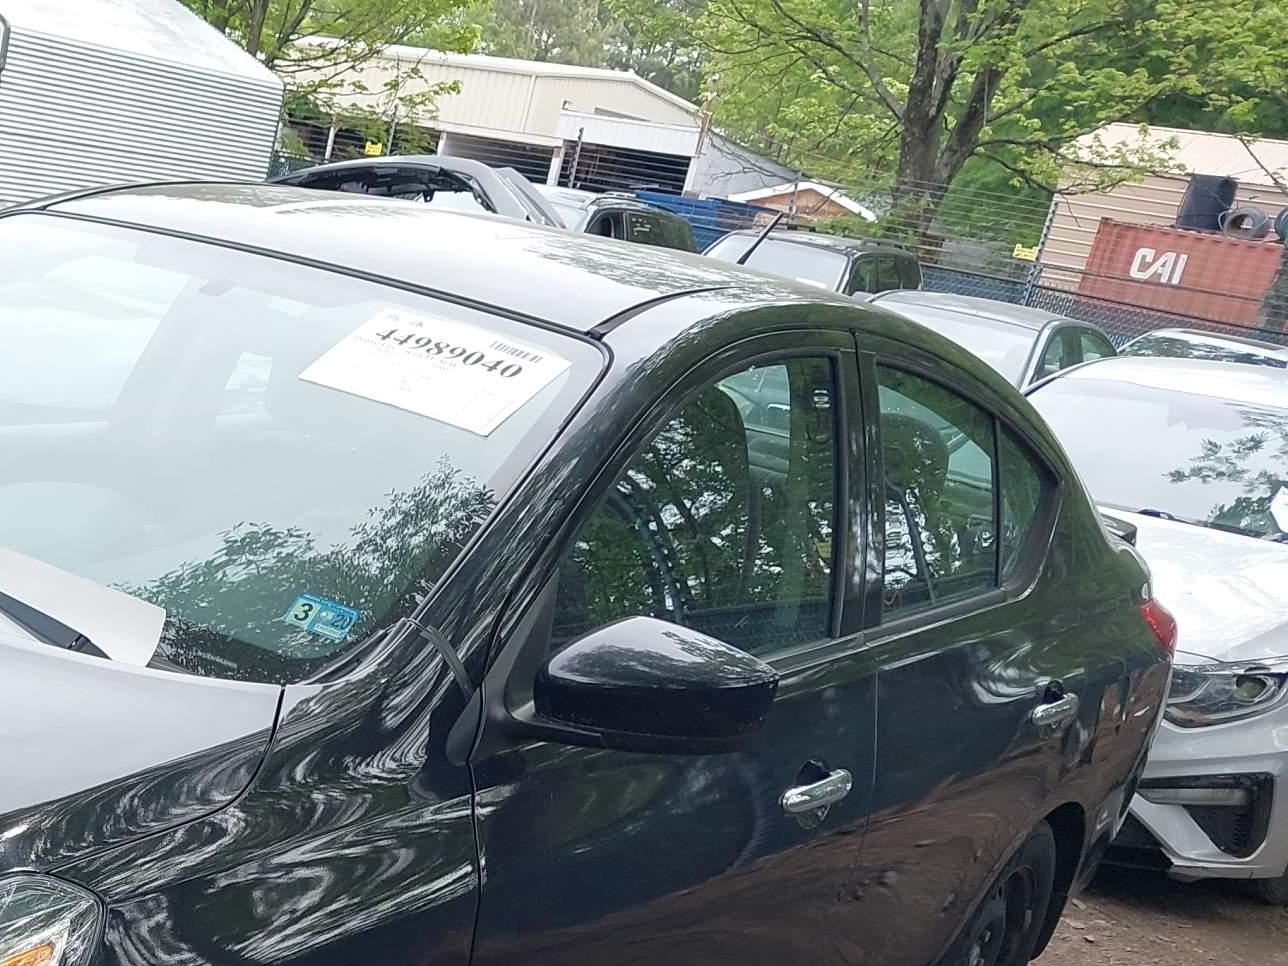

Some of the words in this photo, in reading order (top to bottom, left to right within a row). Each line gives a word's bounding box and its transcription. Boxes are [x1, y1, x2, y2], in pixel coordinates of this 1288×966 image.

[1129, 247, 1189, 285] CAI
[375, 328, 523, 379] 44989040
[293, 602, 314, 622] 3
